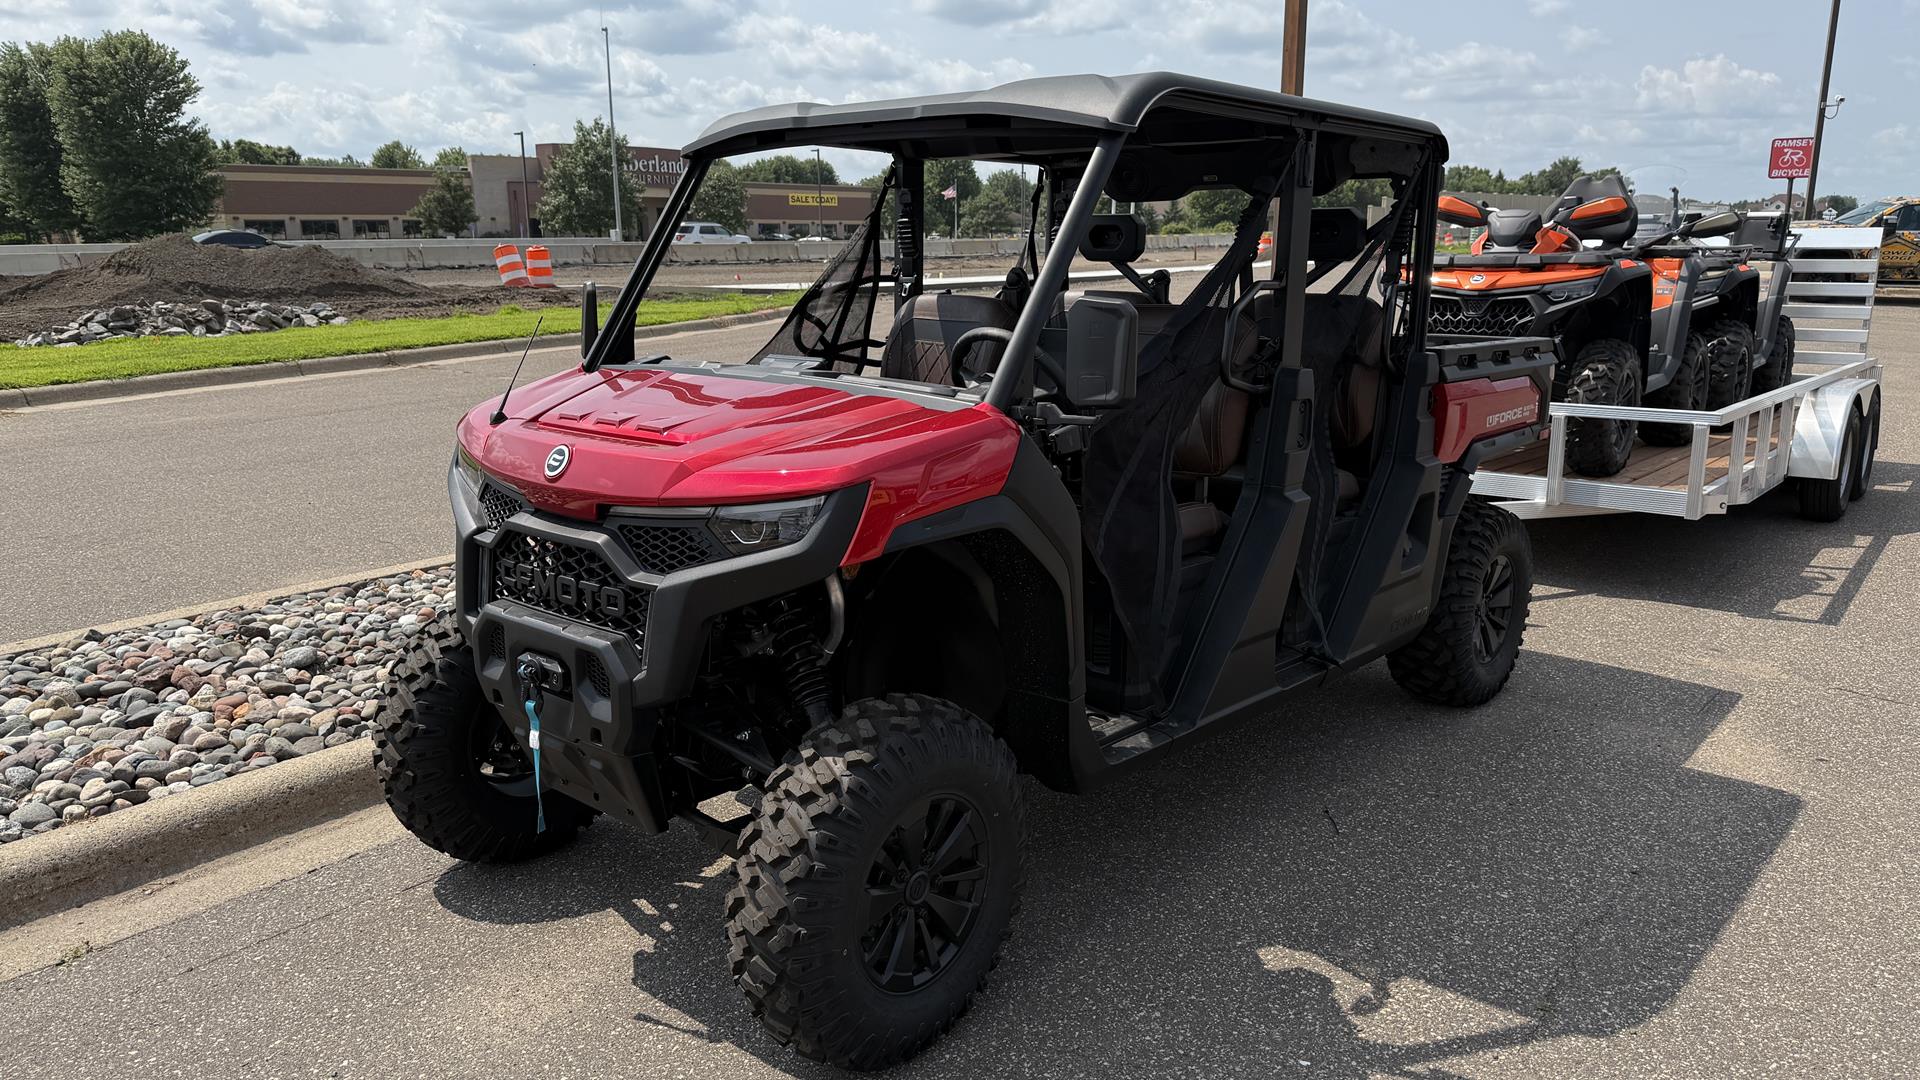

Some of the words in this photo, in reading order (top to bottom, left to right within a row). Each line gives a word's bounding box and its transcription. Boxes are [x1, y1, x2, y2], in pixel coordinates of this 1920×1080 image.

[1774, 139, 1814, 148] RAMSEY
[1771, 168, 1810, 177] BICYCLE
[791, 195, 810, 203] SALE
[811, 196, 836, 204] TODAY!
[500, 558, 626, 619] CFMOTO
